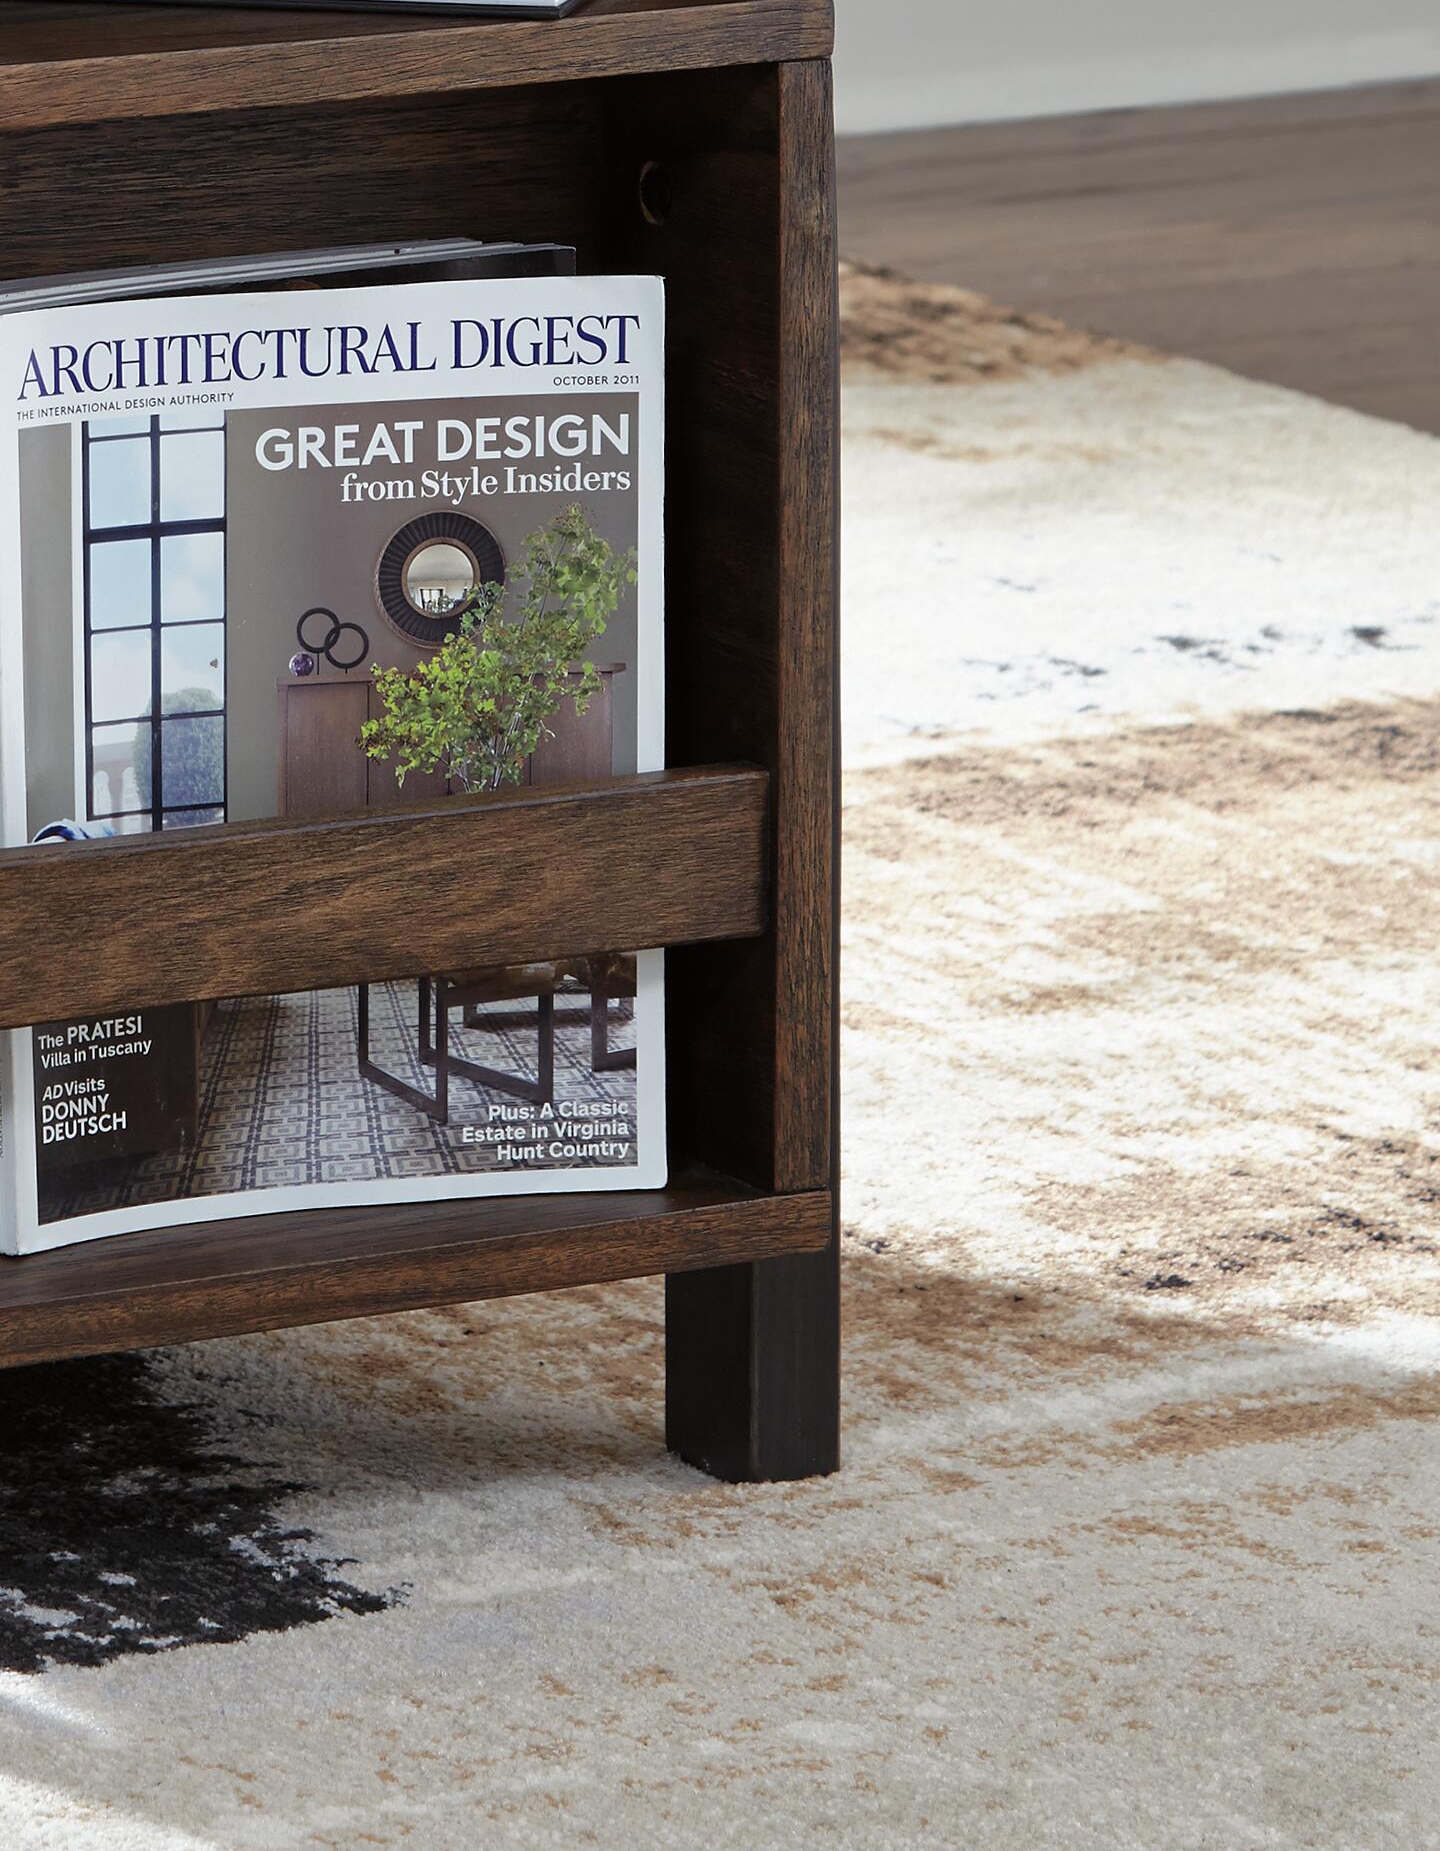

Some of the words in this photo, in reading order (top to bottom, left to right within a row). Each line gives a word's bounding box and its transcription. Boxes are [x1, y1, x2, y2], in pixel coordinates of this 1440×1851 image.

[17, 322, 437, 400] ARCHITECTURAL
[450, 315, 640, 369] DIGEST
[553, 375, 609, 387] OCTOBER
[613, 375, 640, 385] 2011
[16, 411, 34, 421] THE
[37, 400, 121, 419] INTERNATIONAL
[124, 397, 165, 410] DESIGN
[169, 392, 235, 406] AUTHORITY
[255, 421, 424, 471] GREAT
[437, 413, 629, 462] DESIGN
[340, 472, 416, 503] from
[421, 467, 498, 505] Style
[503, 463, 631, 494] Insiders
[38, 1035, 64, 1050] The
[67, 1016, 142, 1045] PRATESI
[41, 1052, 71, 1069] Villa
[74, 1048, 87, 1063] in
[89, 1039, 152, 1060] Tuscany
[42, 1085, 63, 1101] AD
[65, 1078, 105, 1097] Visits
[42, 1094, 109, 1124] DONNY
[489, 1104, 534, 1121] Plus:
[540, 1102, 555, 1119] A
[559, 1100, 629, 1118] Classic
[43, 1111, 127, 1144] DEUTSCH
[462, 1125, 526, 1143] Estate
[531, 1123, 549, 1139] in
[554, 1120, 630, 1139] Virginia
[497, 1143, 544, 1161] Hunt
[549, 1141, 630, 1159] Country
